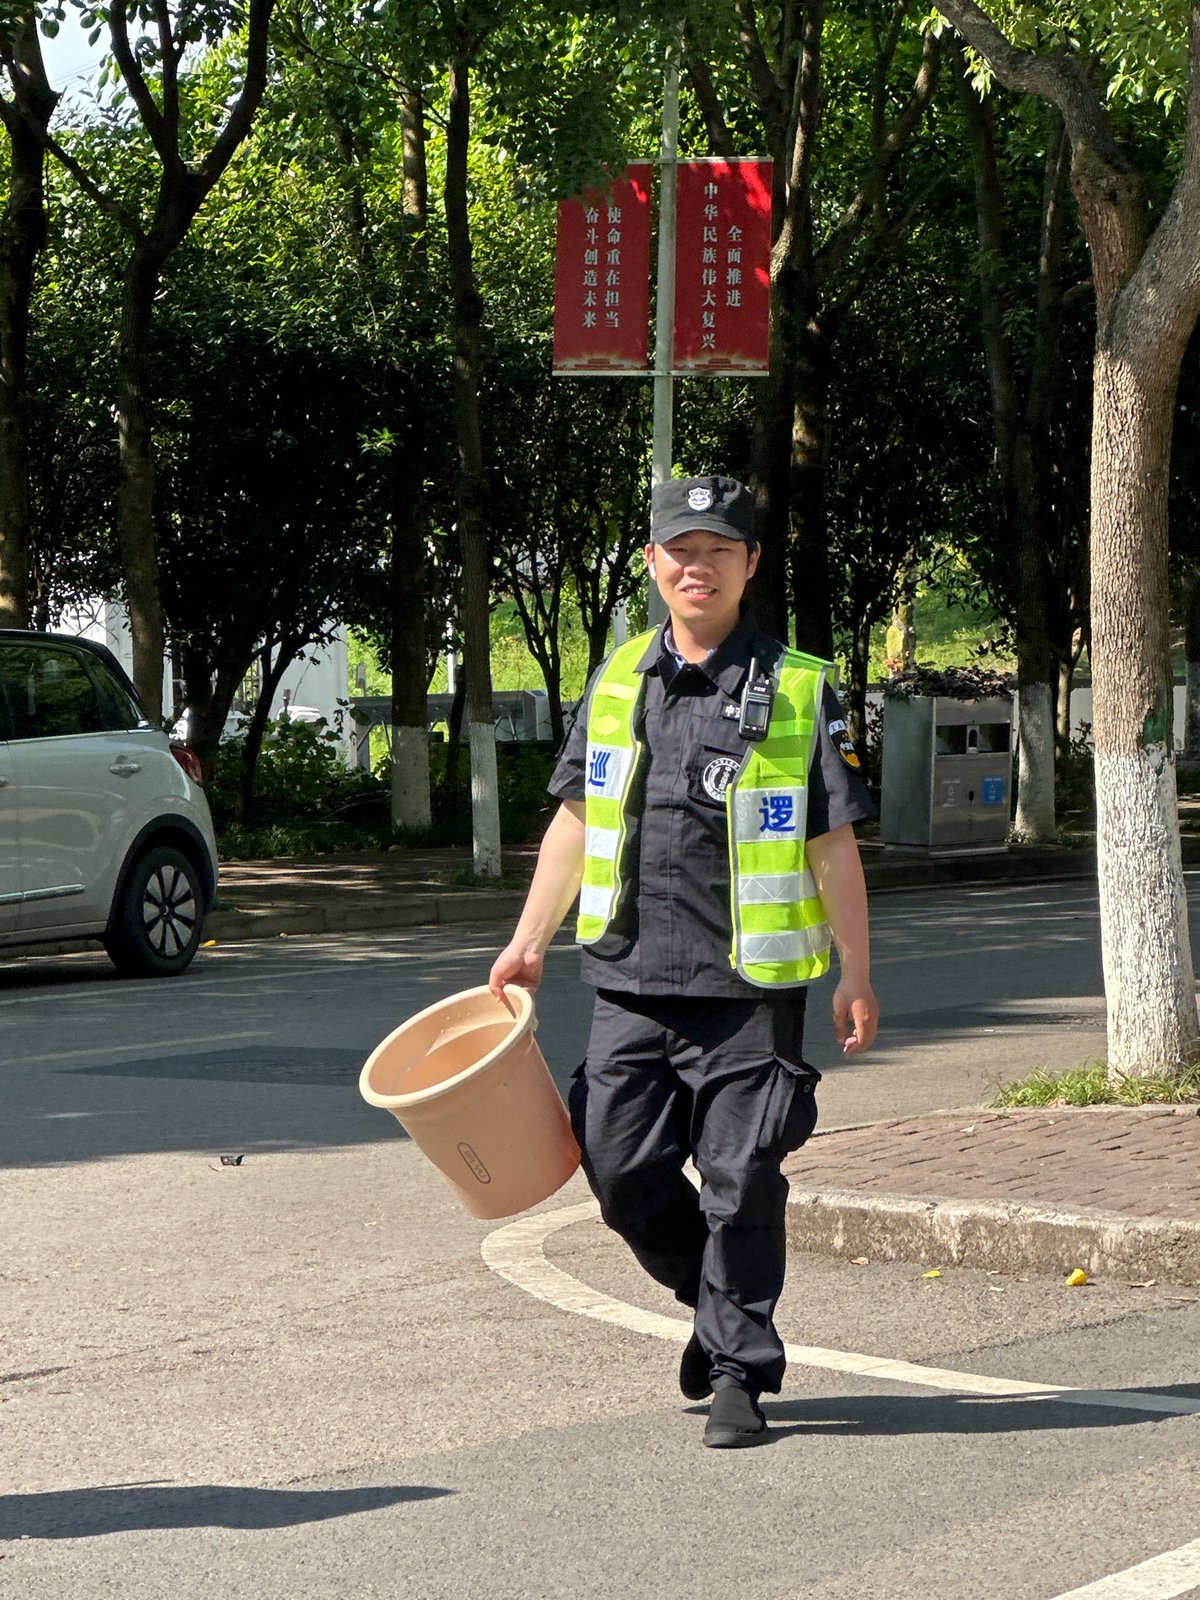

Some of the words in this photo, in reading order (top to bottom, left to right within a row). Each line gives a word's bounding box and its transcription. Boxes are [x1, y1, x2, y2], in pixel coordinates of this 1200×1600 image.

[582, 206, 599, 328] 奋斗创造未来
[604, 206, 622, 328] 使命重在担当
[701, 182, 718, 349] 中华民族伟大复兴
[725, 225, 743, 307] 全面推进
[588, 750, 611, 787] 巡
[759, 795, 796, 833] 逻
